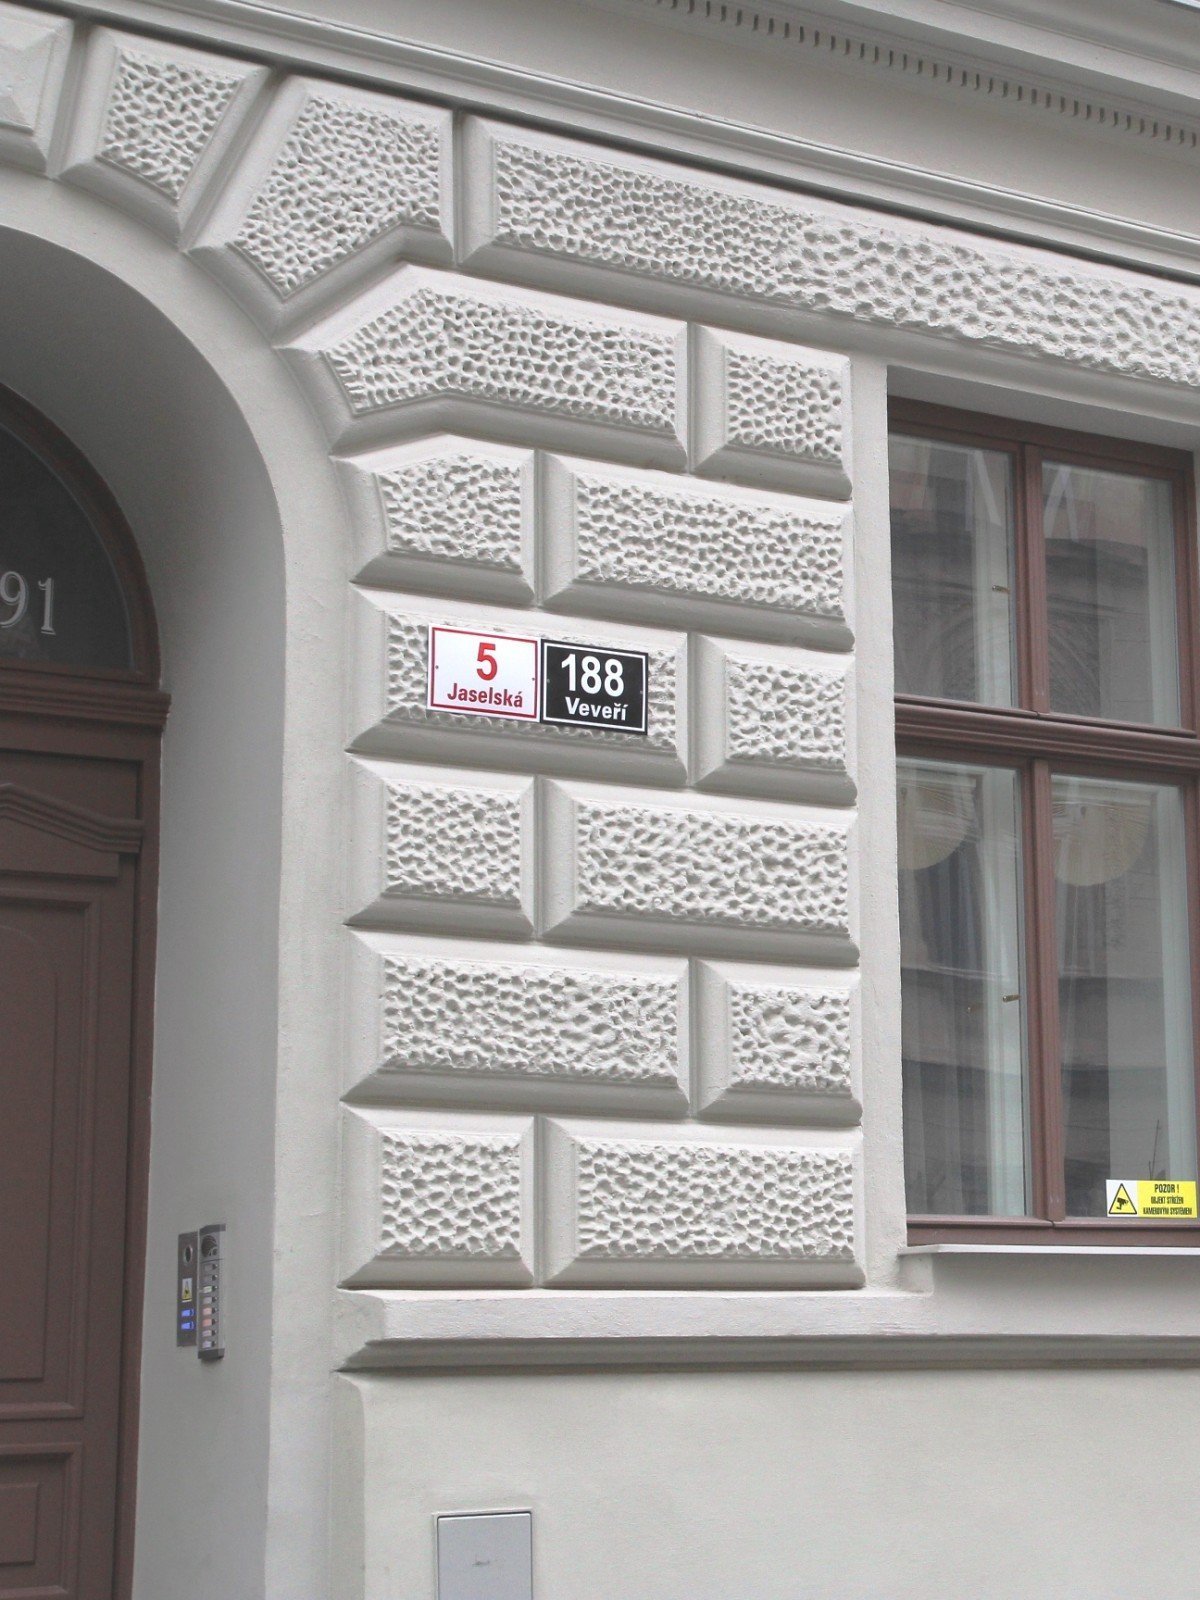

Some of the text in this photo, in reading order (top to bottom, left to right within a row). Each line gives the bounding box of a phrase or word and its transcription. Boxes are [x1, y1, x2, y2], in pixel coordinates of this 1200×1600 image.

[476, 642, 498, 681] 5
[561, 653, 625, 697] 188
[447, 683, 523, 708] Jaselská
[565, 696, 627, 721] Veveří
[1154, 1183, 1175, 1193] POZOR
